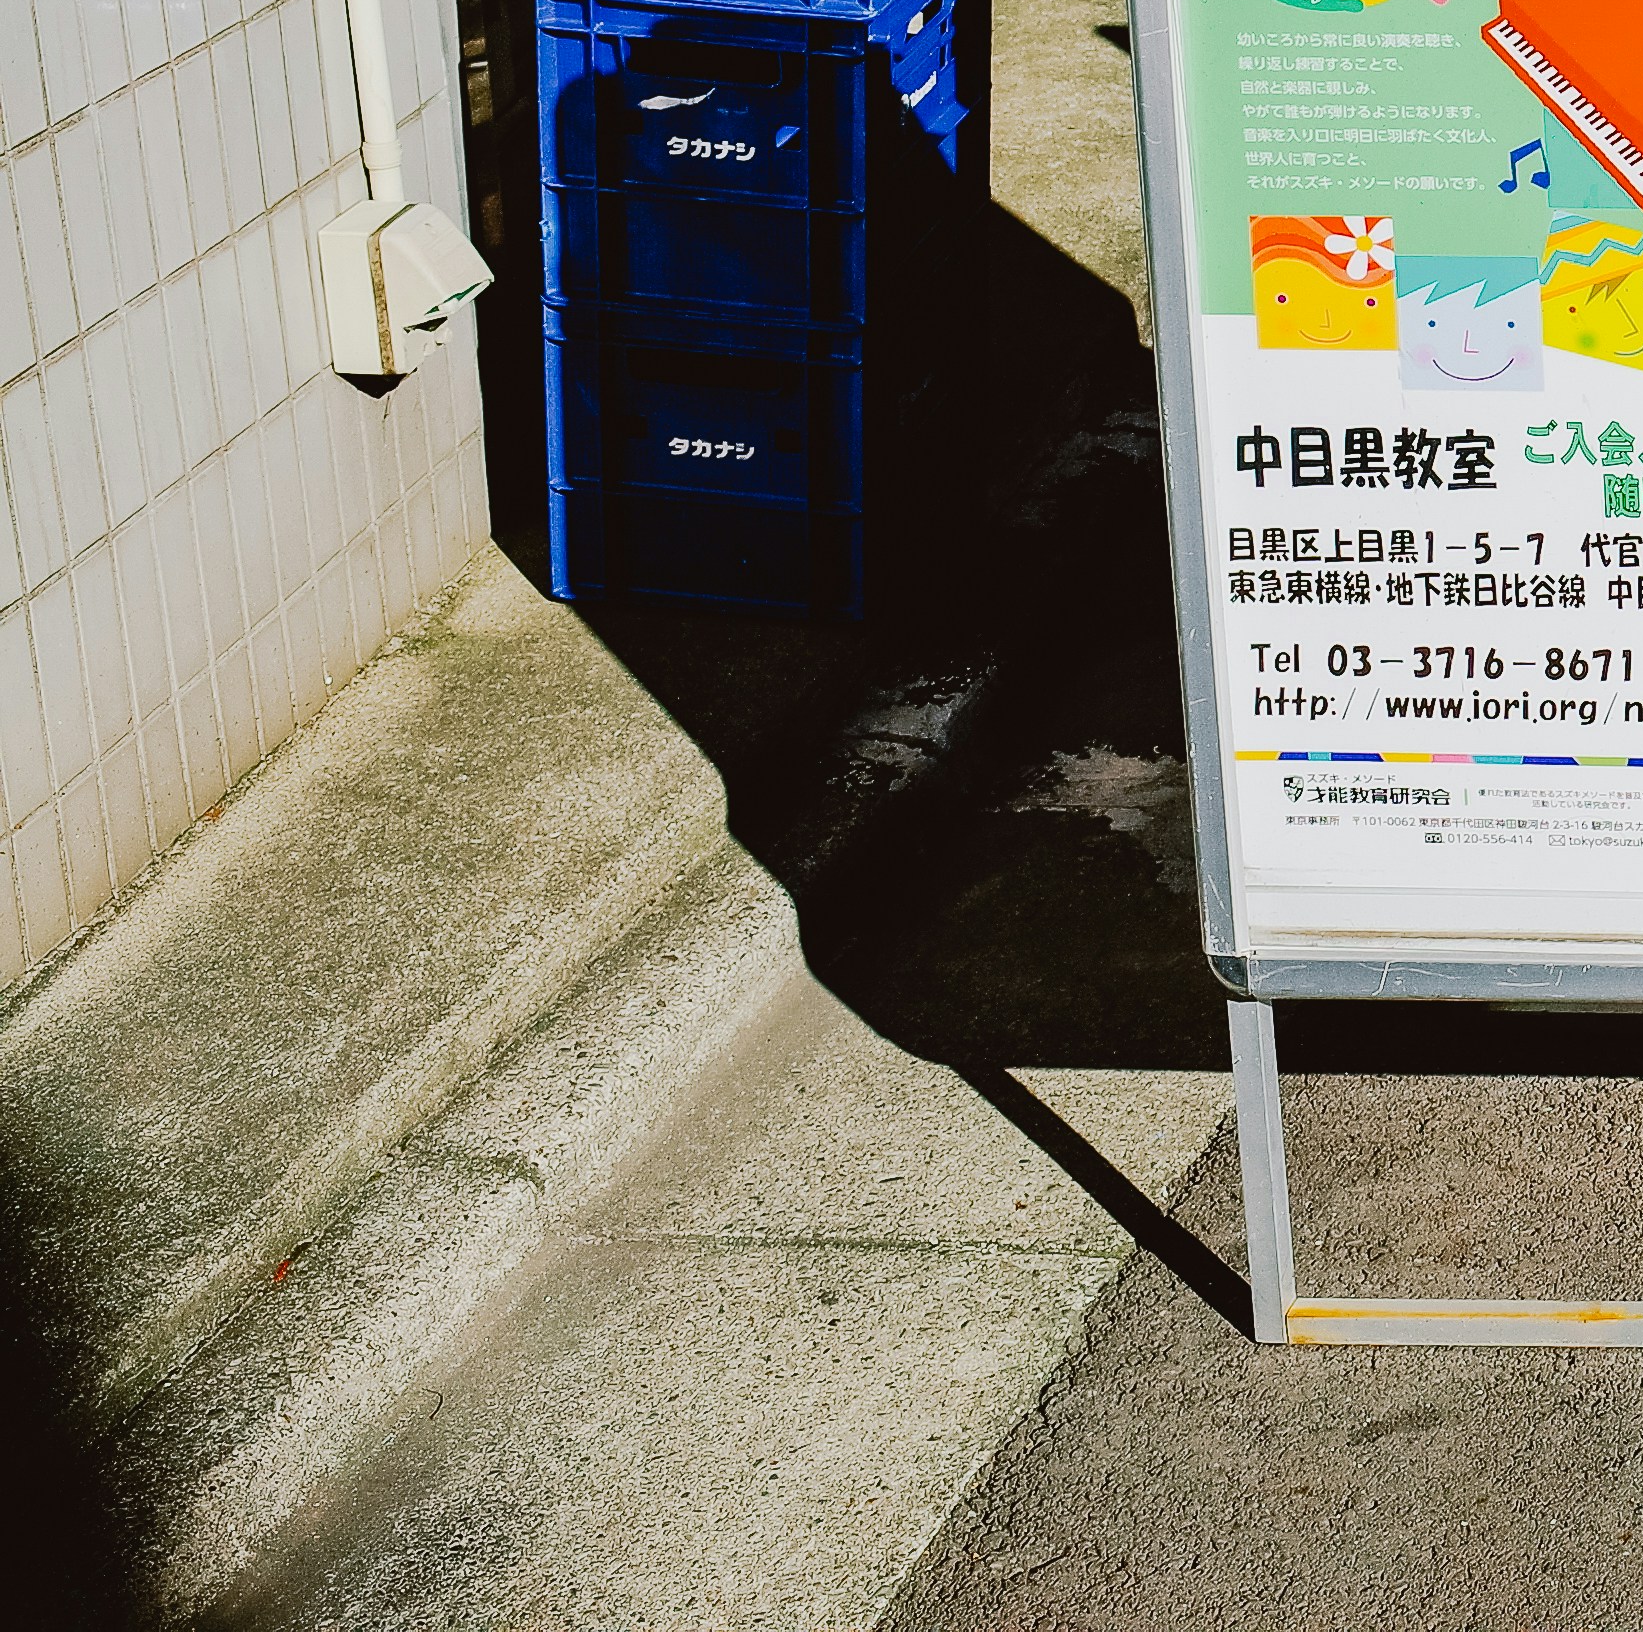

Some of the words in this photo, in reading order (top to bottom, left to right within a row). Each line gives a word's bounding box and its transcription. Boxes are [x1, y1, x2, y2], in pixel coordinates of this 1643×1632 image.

[667, 136, 755, 161] タカナシ
[669, 438, 754, 460] タカナシ
[1237, 425, 1497, 490] 中目黒教室
[1250, 643, 1300, 673] Tel
[1328, 644, 1632, 682] 03-3716-8671
[1307, 773, 1396, 784] スズキ・メソード
[1307, 786, 1451, 805] 才能教育研究会
[1448, 834, 1532, 844] 0120-556-414
